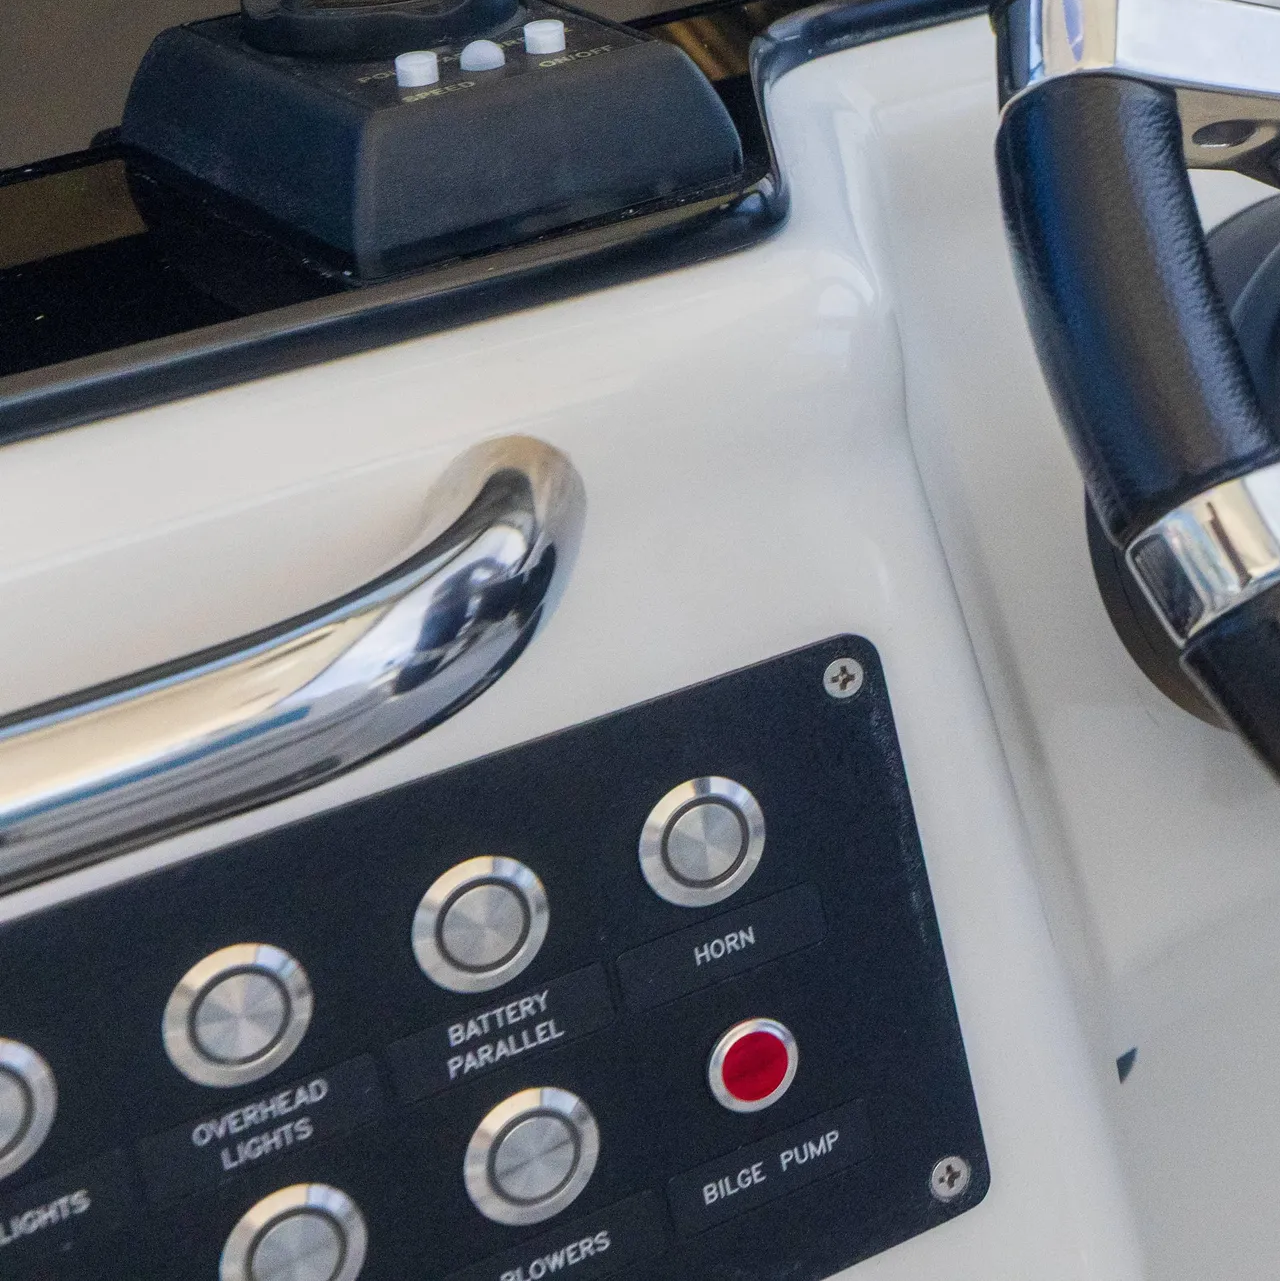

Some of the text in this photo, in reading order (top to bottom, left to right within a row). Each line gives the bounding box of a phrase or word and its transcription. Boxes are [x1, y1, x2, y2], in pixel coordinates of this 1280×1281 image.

[538, 44, 615, 68] ON/OFF
[401, 80, 476, 104] SPEED
[693, 926, 756, 966] HORN
[447, 989, 550, 1048] BATTERY
[446, 1019, 565, 1080] PARALLEL
[191, 1077, 329, 1147] OVERHEAD
[220, 1116, 315, 1171] LIGHTS
[702, 1130, 840, 1206] BILGE PUMP
